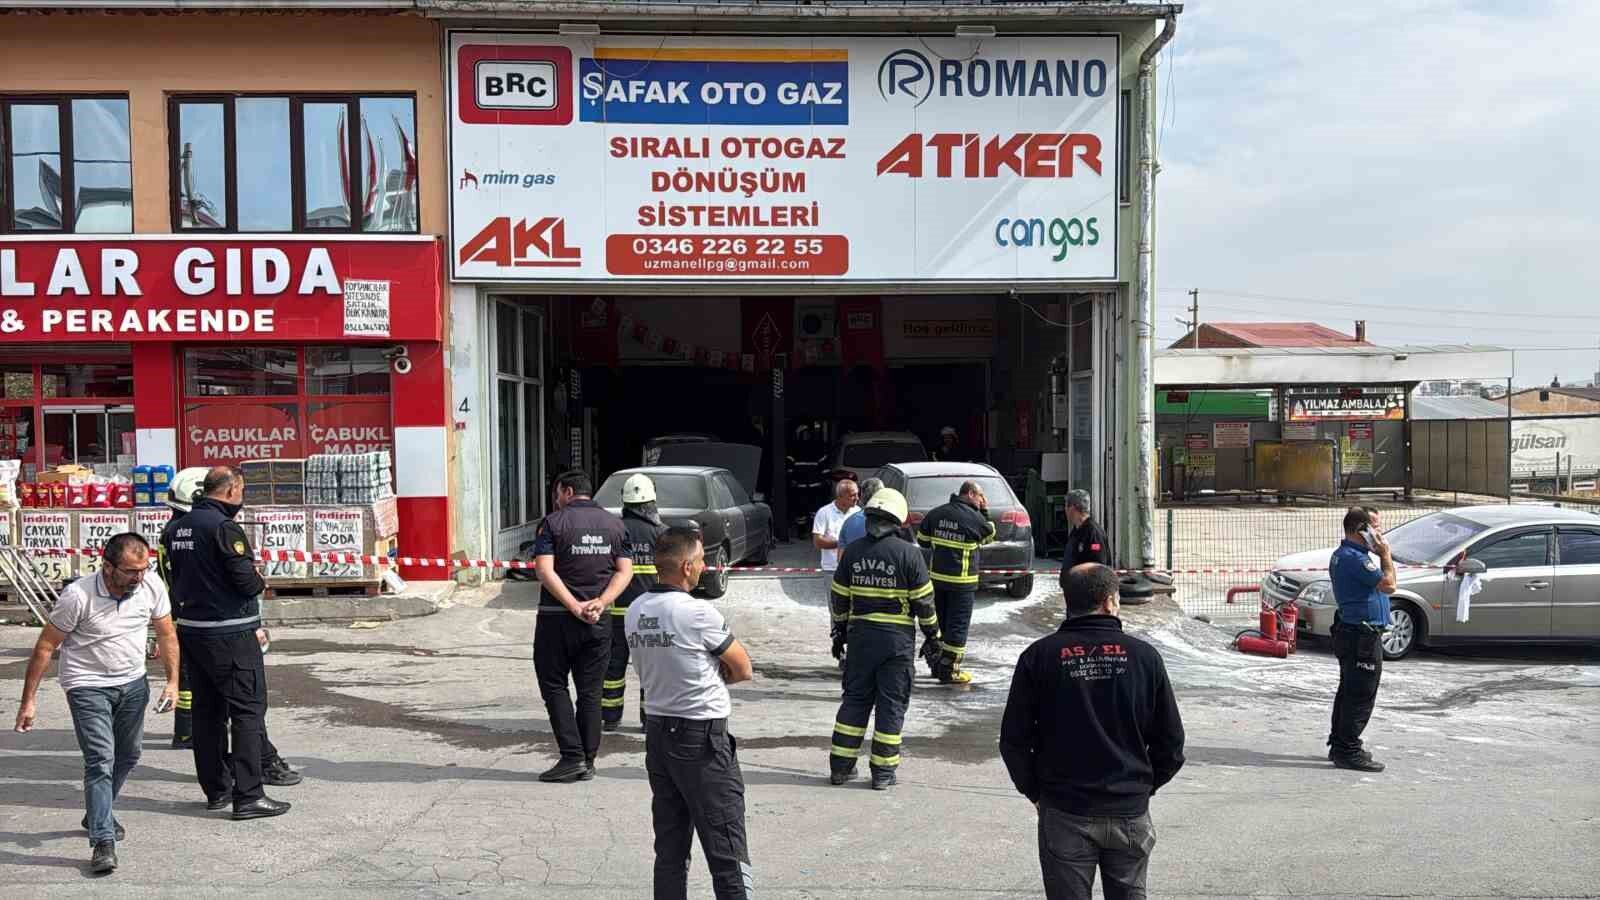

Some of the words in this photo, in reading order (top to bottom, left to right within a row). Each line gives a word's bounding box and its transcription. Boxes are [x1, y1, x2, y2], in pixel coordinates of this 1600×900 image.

[485, 72, 547, 97] BRC
[940, 59, 1107, 97] ROMANO
[582, 72, 690, 106] ŞAFAK
[701, 82, 766, 105] OTO
[777, 82, 842, 105] GAZ
[609, 136, 710, 159] SIRALI
[721, 137, 846, 159] OTOGAZ
[483, 170, 519, 185] mim
[522, 172, 555, 189] gas
[651, 167, 806, 198] DÖNÜŞÜM
[637, 200, 819, 227] SİSTEMLERİ
[459, 217, 581, 268] AKL
[632, 238, 694, 255] 0346
[702, 238, 748, 255] 226
[755, 238, 786, 254] 22
[793, 238, 823, 254] 55
[0, 247, 142, 296] LAR
[174, 247, 342, 296] GIDA
[644, 257, 810, 272] uzmanellpg@gmail.com
[0, 309, 25, 333] &
[42, 309, 275, 332] PERAKENDE
[459, 397, 471, 413] 4
[1303, 399, 1340, 409] YILMAZ
[1341, 399, 1388, 409] AMBALAJ
[190, 427, 296, 445] ÇABUKLAR
[1511, 434, 1567, 453] gülsan
[203, 445, 284, 459] MARKET
[81, 515, 127, 523] indirim
[138, 512, 172, 520] indiri
[257, 513, 304, 522] indirim
[315, 511, 361, 519] indirim
[90, 526, 113, 537] TOZ
[319, 533, 355, 545] SODA
[263, 536, 285, 547] SU
[852, 557, 896, 576] SİVAS
[851, 574, 897, 587] İTFAİYESİ
[1060, 646, 1085, 657] AS
[1103, 644, 1127, 655] EL
